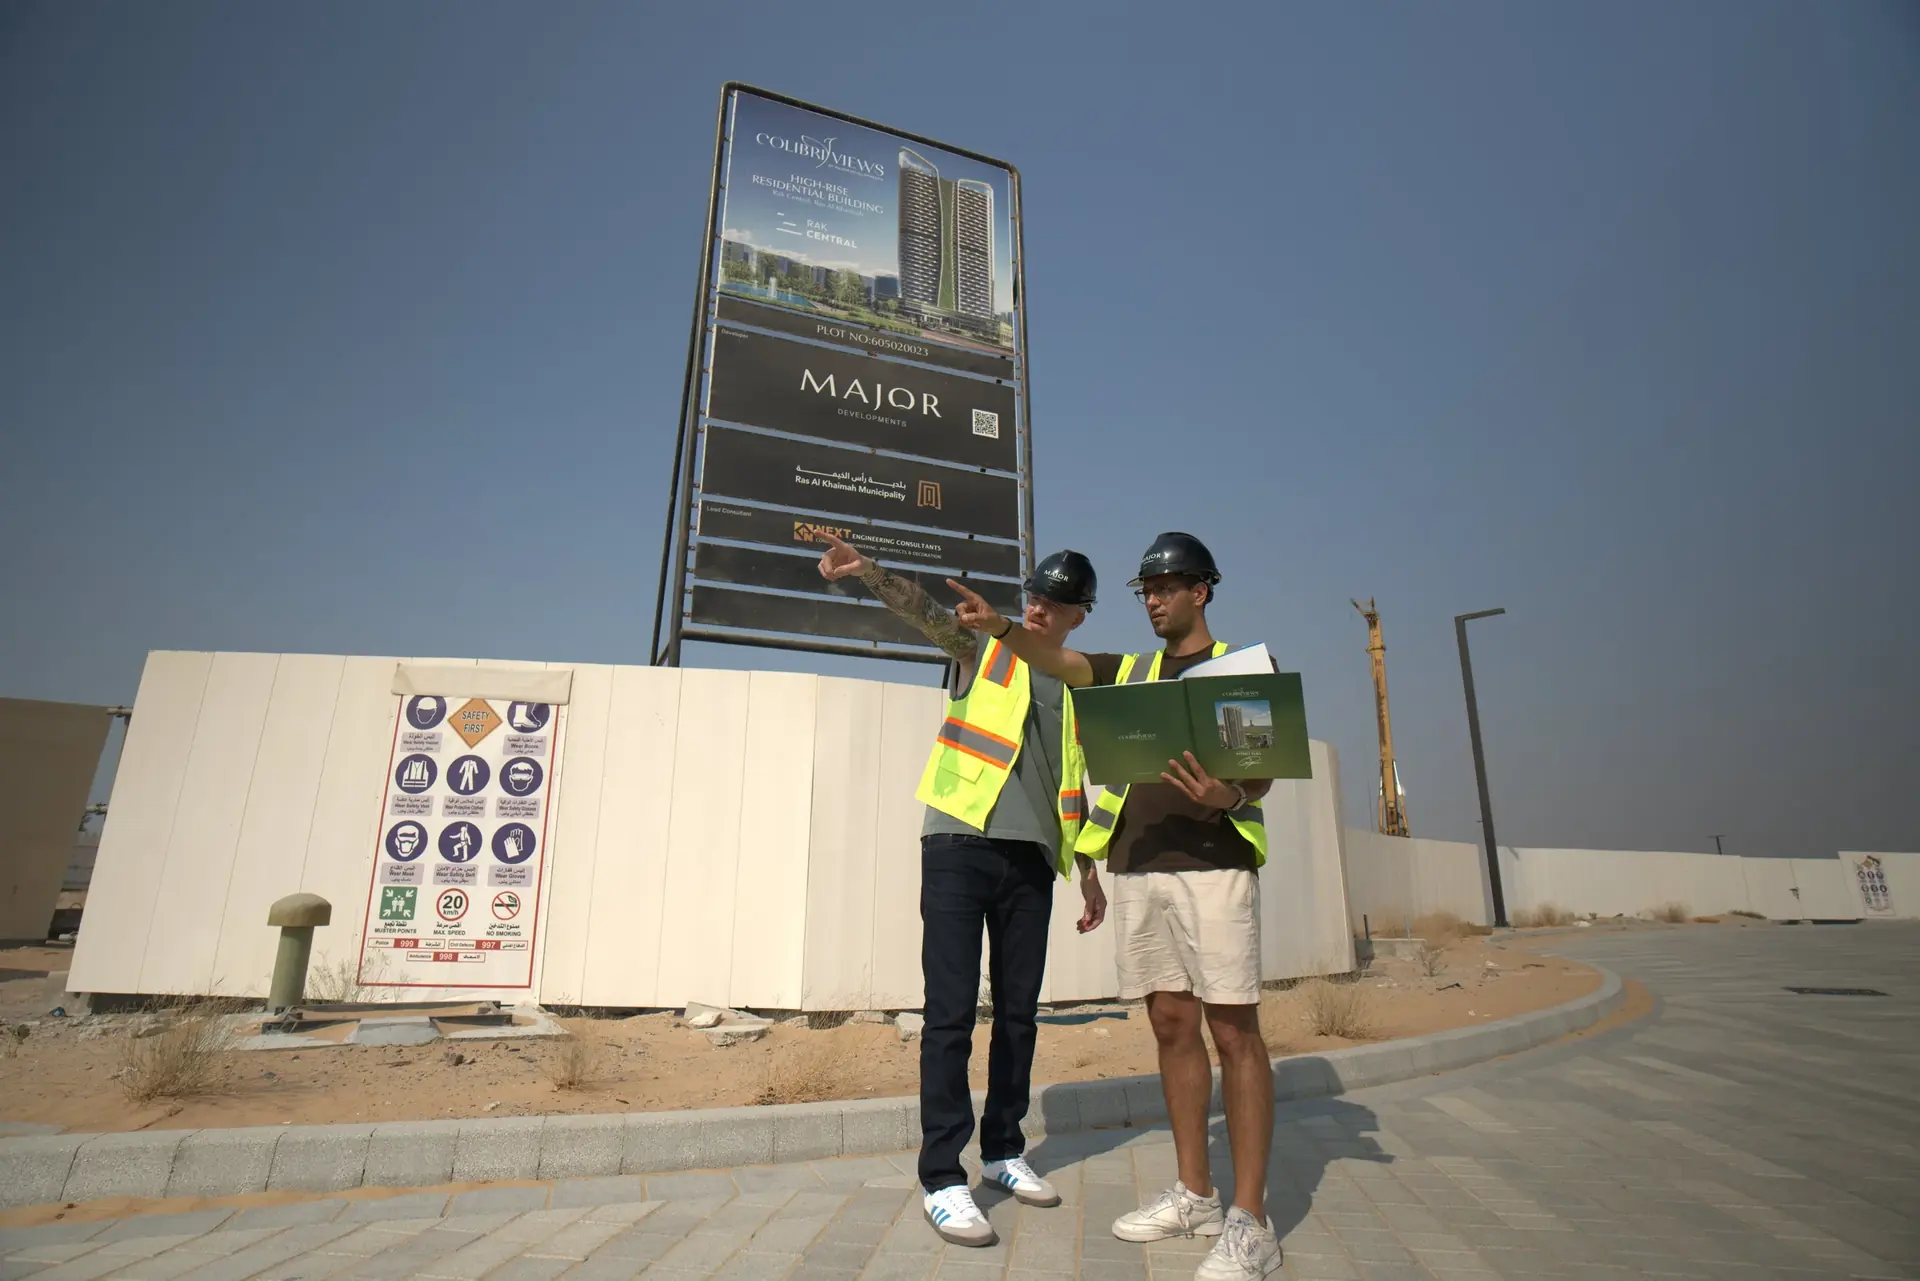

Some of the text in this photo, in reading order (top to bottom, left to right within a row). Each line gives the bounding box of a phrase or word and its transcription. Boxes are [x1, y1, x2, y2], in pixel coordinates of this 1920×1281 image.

[756, 132, 826, 161] COLIBRI
[832, 152, 884, 177] VIEWS
[752, 174, 884, 214] RESIDENTIAL BUILDING
[790, 174, 849, 197] HIGH-RISE
[806, 219, 828, 231] RAK
[806, 230, 858, 249] CENTRAL
[817, 324, 929, 357] PLOT NO:605020023
[800, 368, 942, 418] MAJOR
[837, 408, 907, 428] DEVELOPMENTS
[850, 472, 867, 484] رأس
[795, 475, 906, 502] Ras Al Khaimah Municipality
[852, 533, 895, 545] ENGINEERING
[896, 540, 942, 551] CONSULTANTS
[1043, 569, 1069, 582] MAJOR
[462, 710, 490, 721] SAFETY
[464, 723, 485, 734] FIRST
[442, 895, 464, 909] 20
[400, 940, 414, 948] 999
[481, 941, 496, 949] 997
